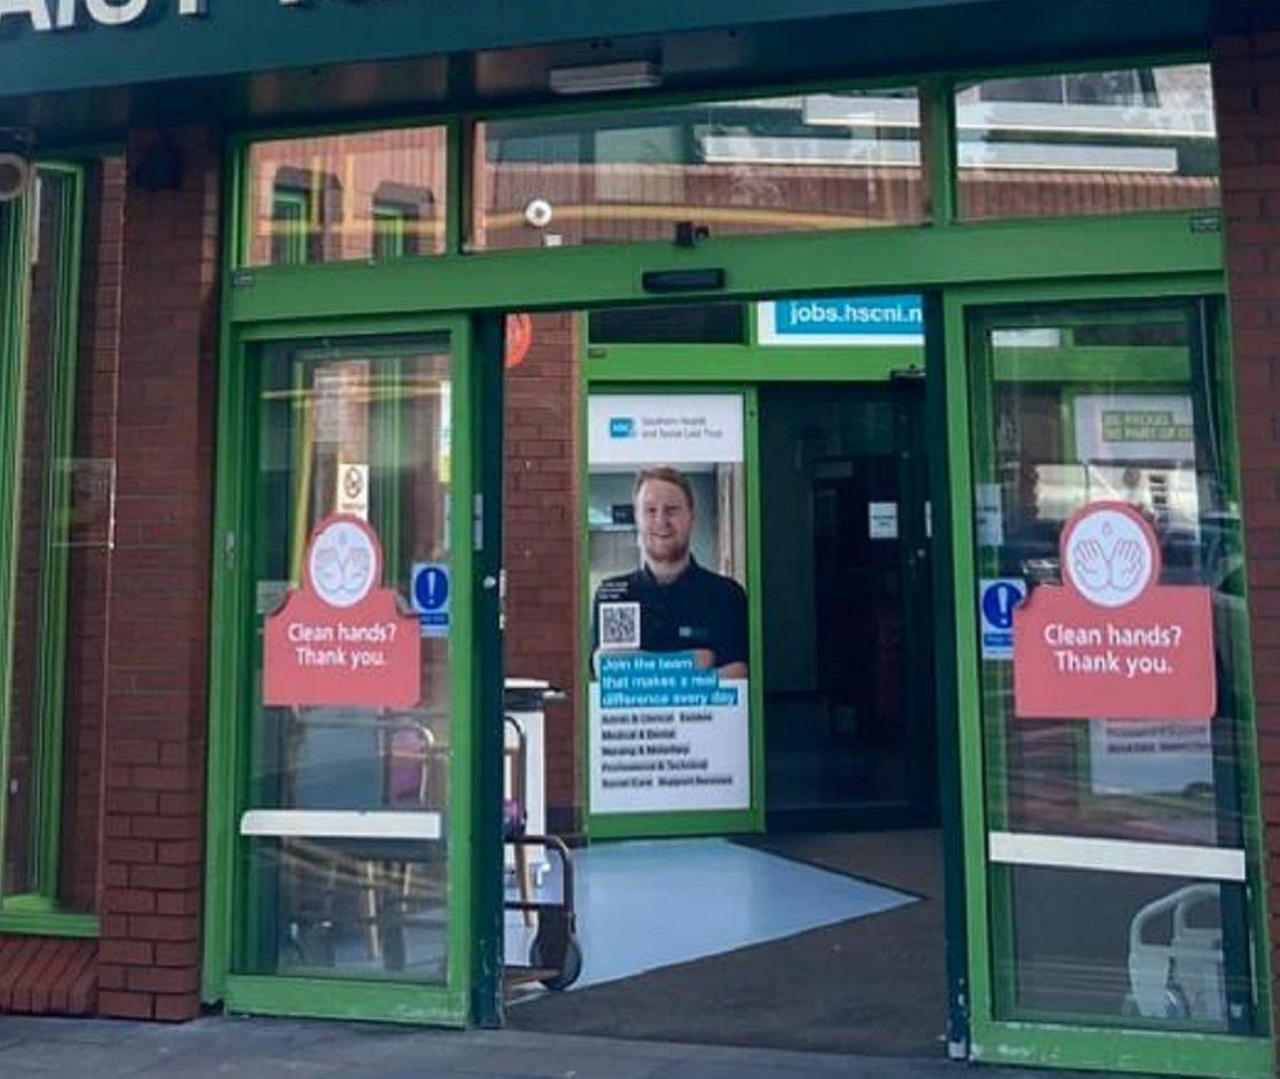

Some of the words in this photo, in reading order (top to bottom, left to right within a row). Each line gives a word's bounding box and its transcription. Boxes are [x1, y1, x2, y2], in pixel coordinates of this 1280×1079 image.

[288, 623, 333, 642] Clean
[337, 622, 397, 642] hands?
[1043, 624, 1102, 646] Clean
[1107, 624, 1181, 647] hands?
[295, 647, 347, 666] Thank
[351, 650, 388, 671] you.
[602, 658, 631, 670] Join
[634, 657, 655, 669] the
[658, 657, 693, 669] team
[1054, 651, 1119, 672] Thank
[1125, 655, 1173, 678] you.
[602, 676, 628, 689] that
[631, 675, 675, 688] makes
[602, 691, 670, 705] difference
[671, 692, 708, 707] every
[710, 690, 735, 707] day
